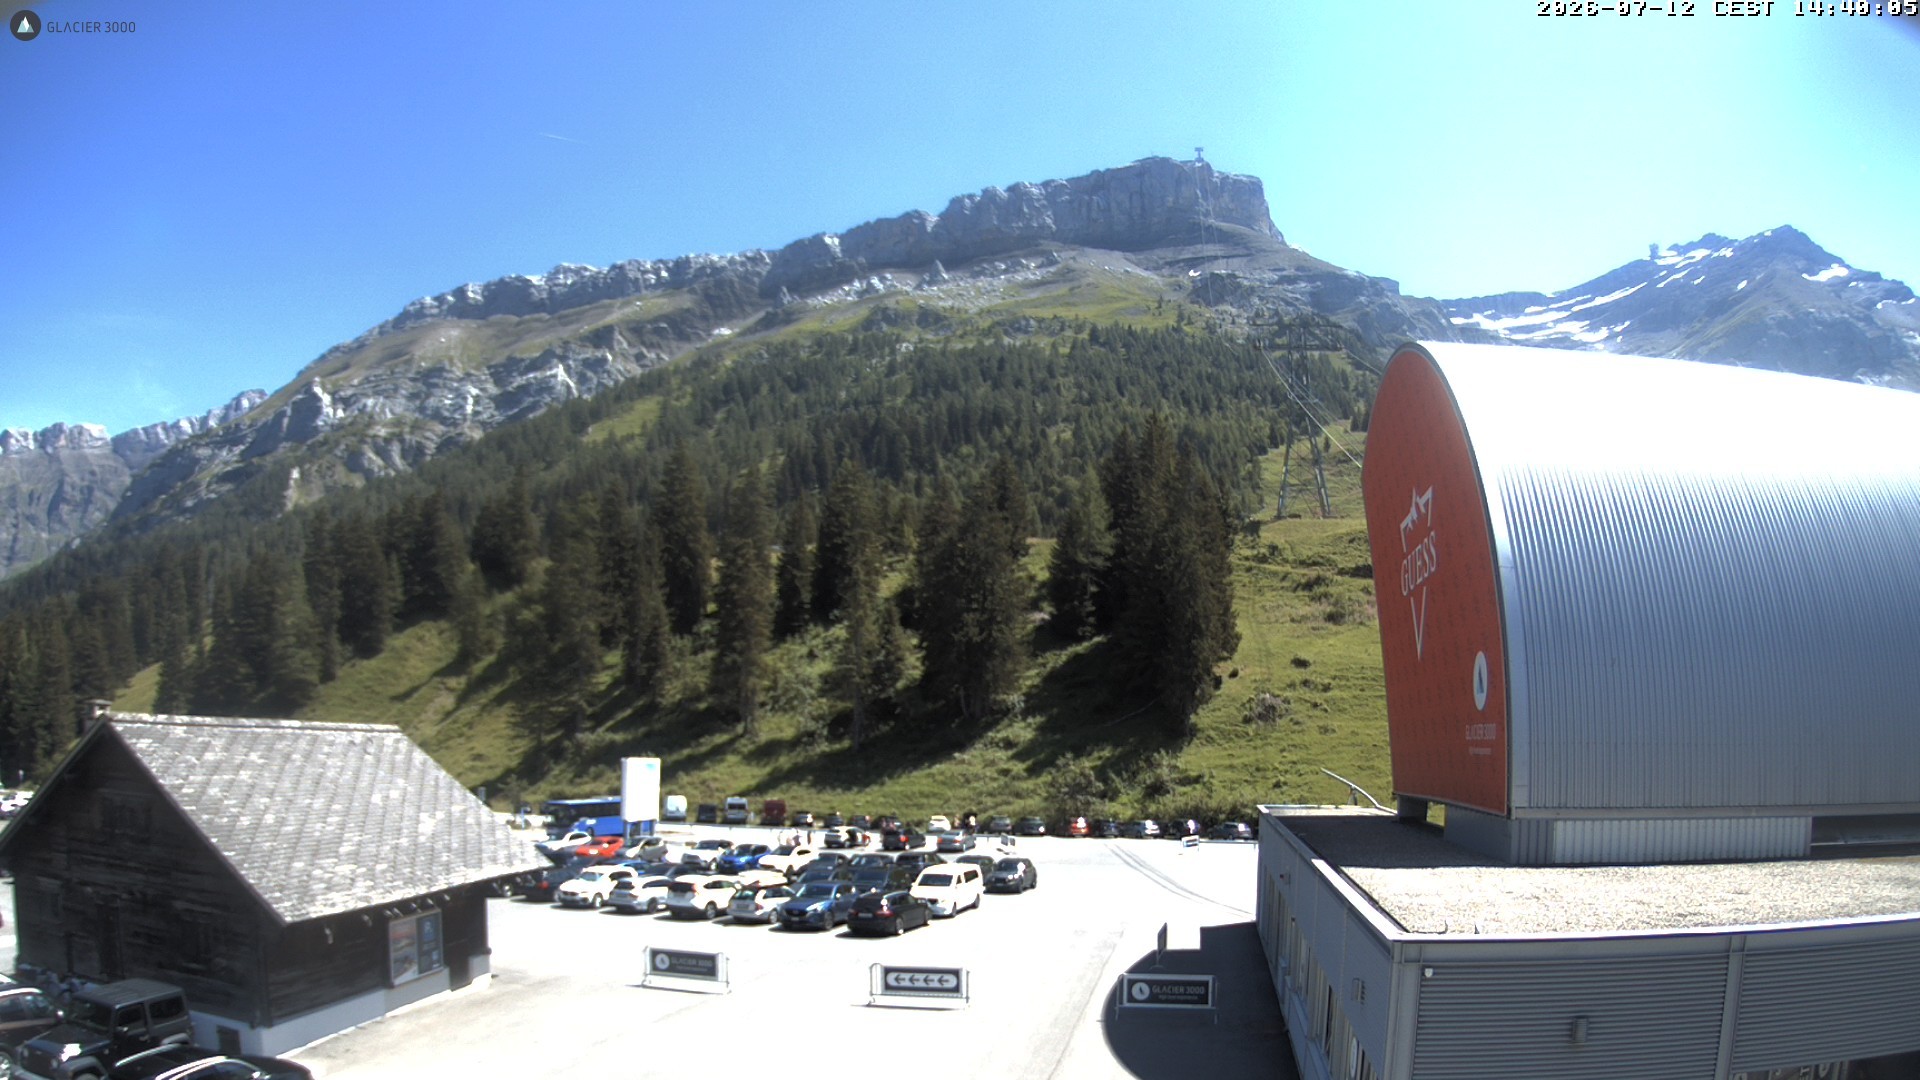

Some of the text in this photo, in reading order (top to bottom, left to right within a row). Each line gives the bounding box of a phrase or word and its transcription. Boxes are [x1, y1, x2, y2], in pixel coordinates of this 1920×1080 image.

[1401, 530, 1437, 597] GUESS
[1152, 985, 1205, 995] GLACIER 3000
